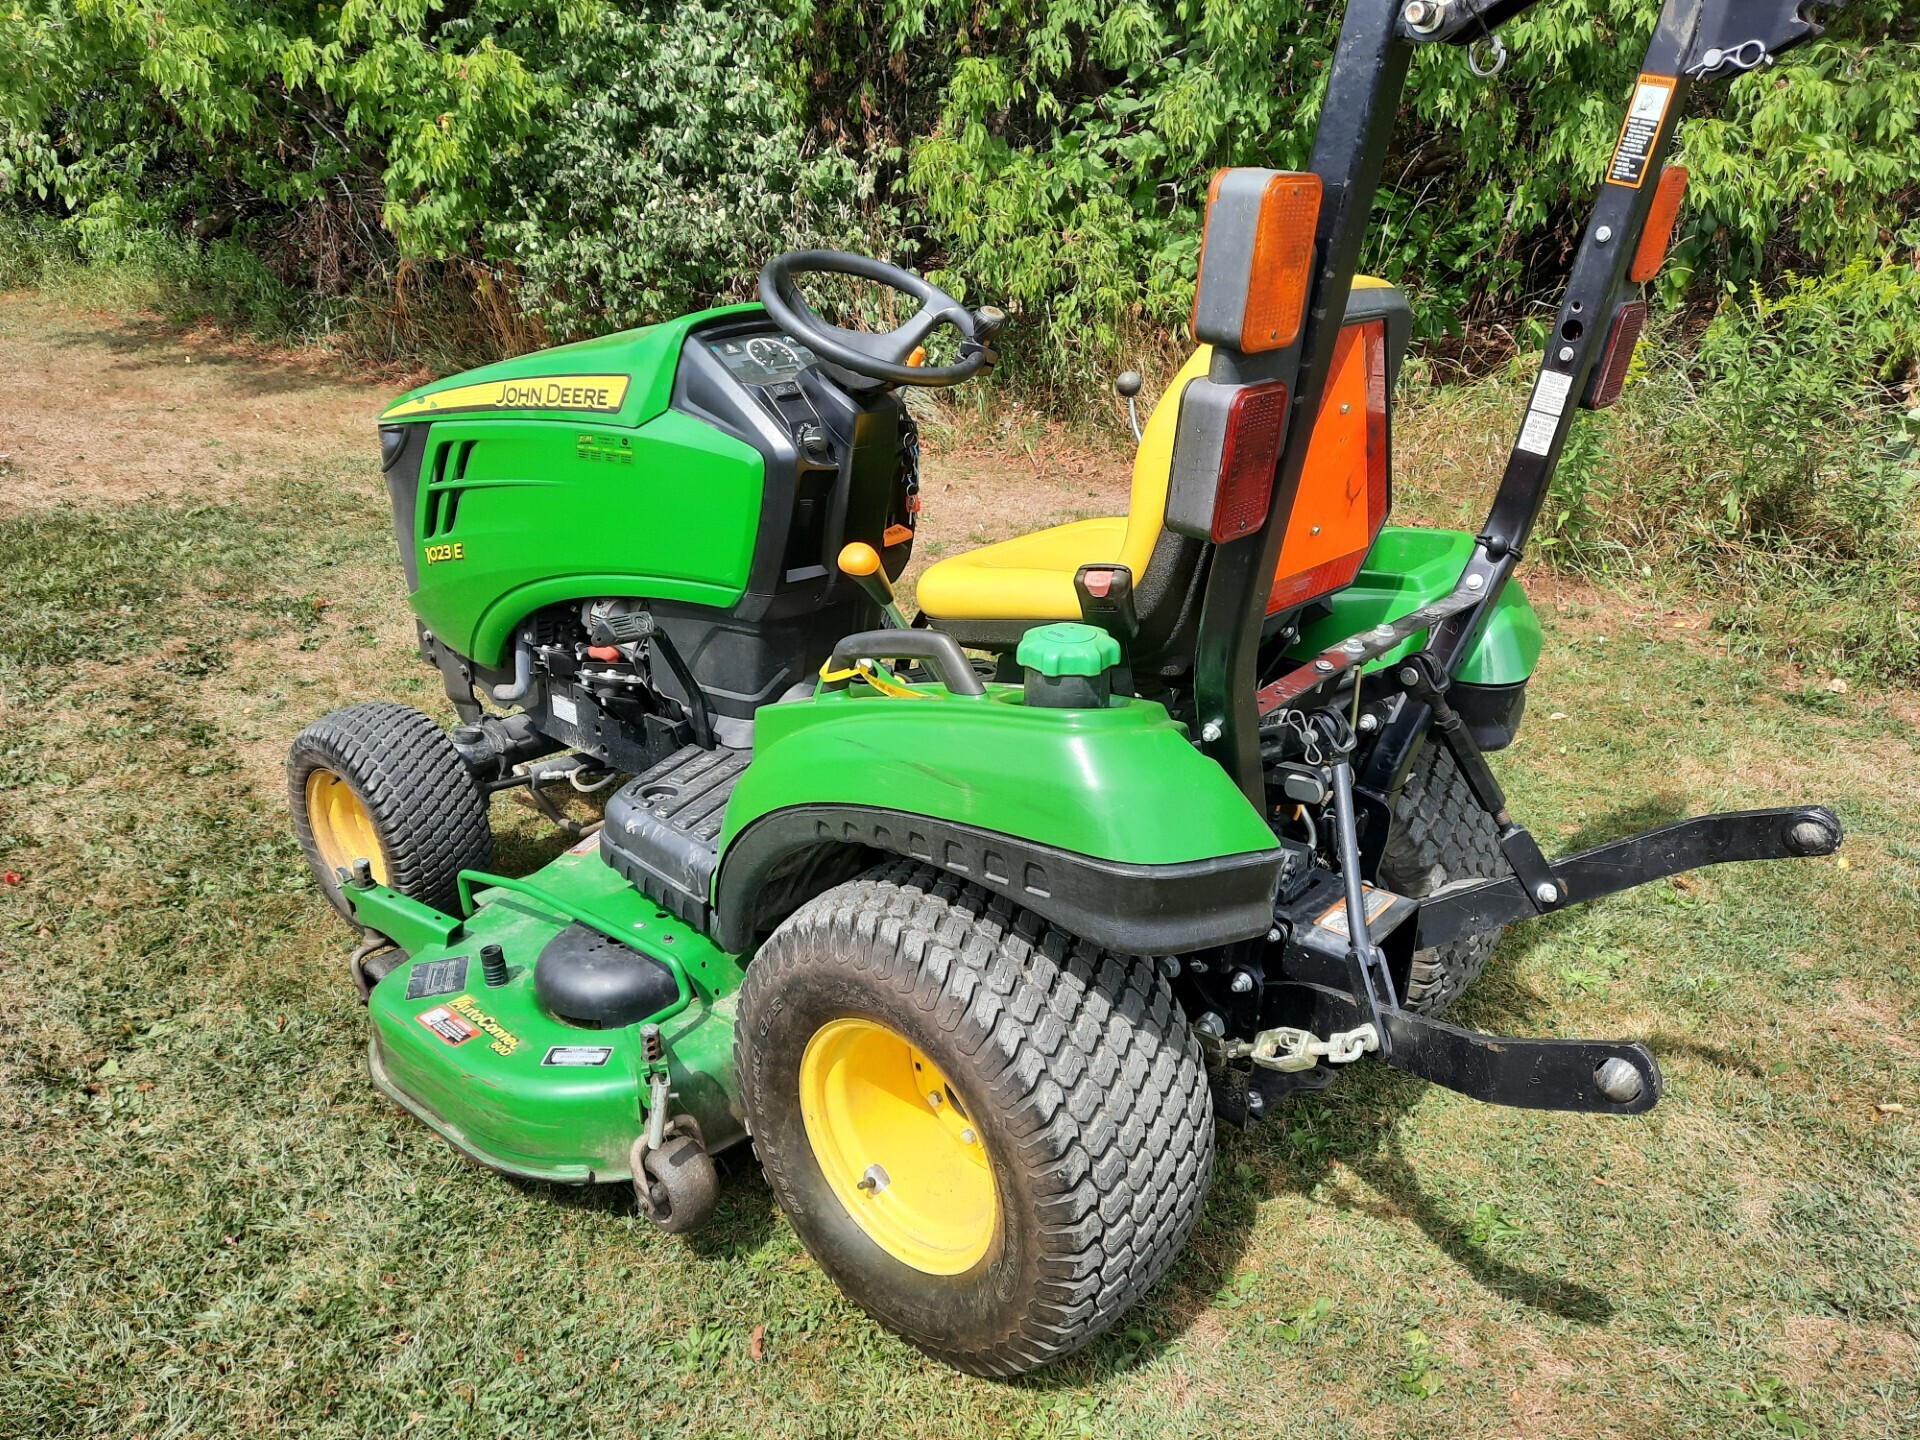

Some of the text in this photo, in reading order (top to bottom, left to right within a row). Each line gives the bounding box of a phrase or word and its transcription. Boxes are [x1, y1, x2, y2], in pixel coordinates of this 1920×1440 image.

[496, 383, 609, 405] JOHN DEERE
[424, 541, 464, 566] 1023 E
[489, 1040, 513, 1057] 60D
